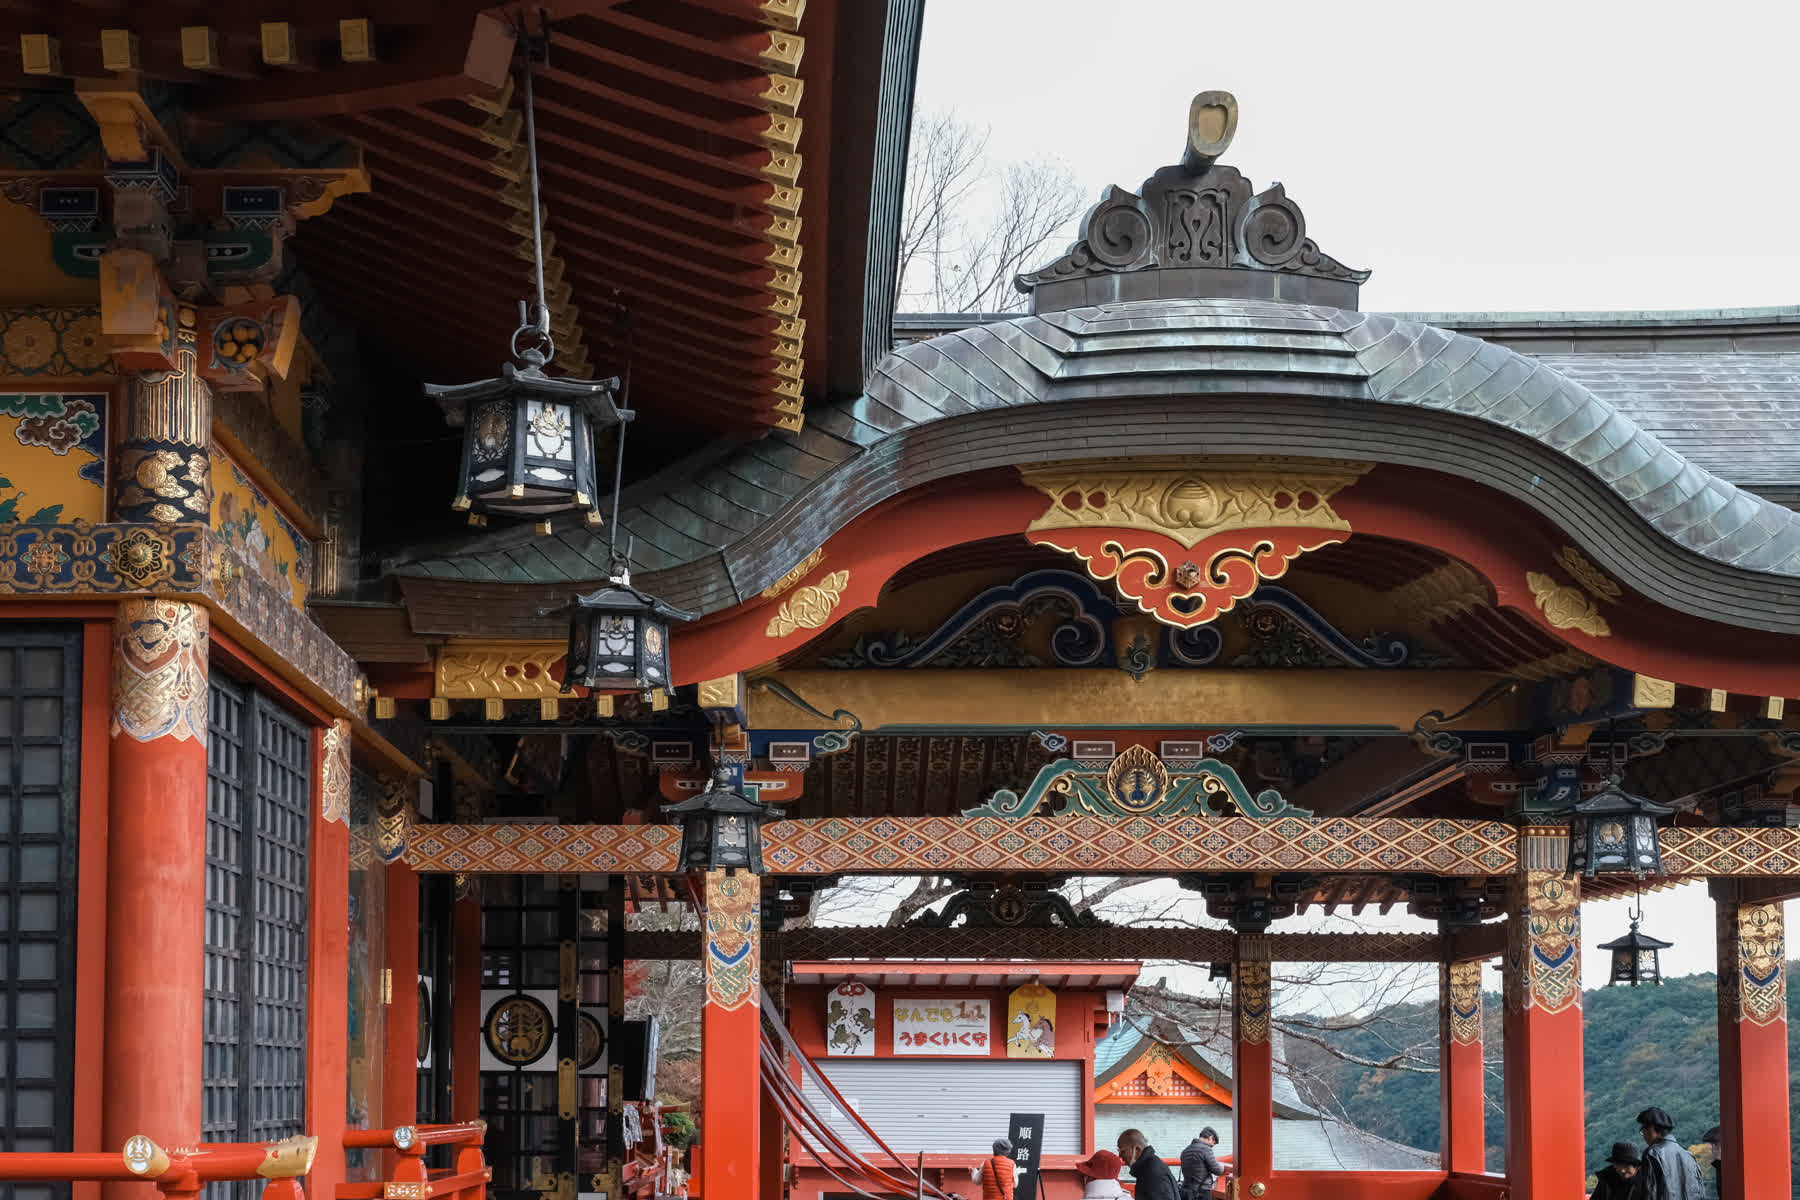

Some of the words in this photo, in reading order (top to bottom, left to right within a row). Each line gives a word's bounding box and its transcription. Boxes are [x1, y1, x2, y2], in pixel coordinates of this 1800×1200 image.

[895, 1007, 954, 1022] なんでも
[899, 1031, 987, 1046] うまくいく守
[1016, 1126, 1032, 1161] 順路
